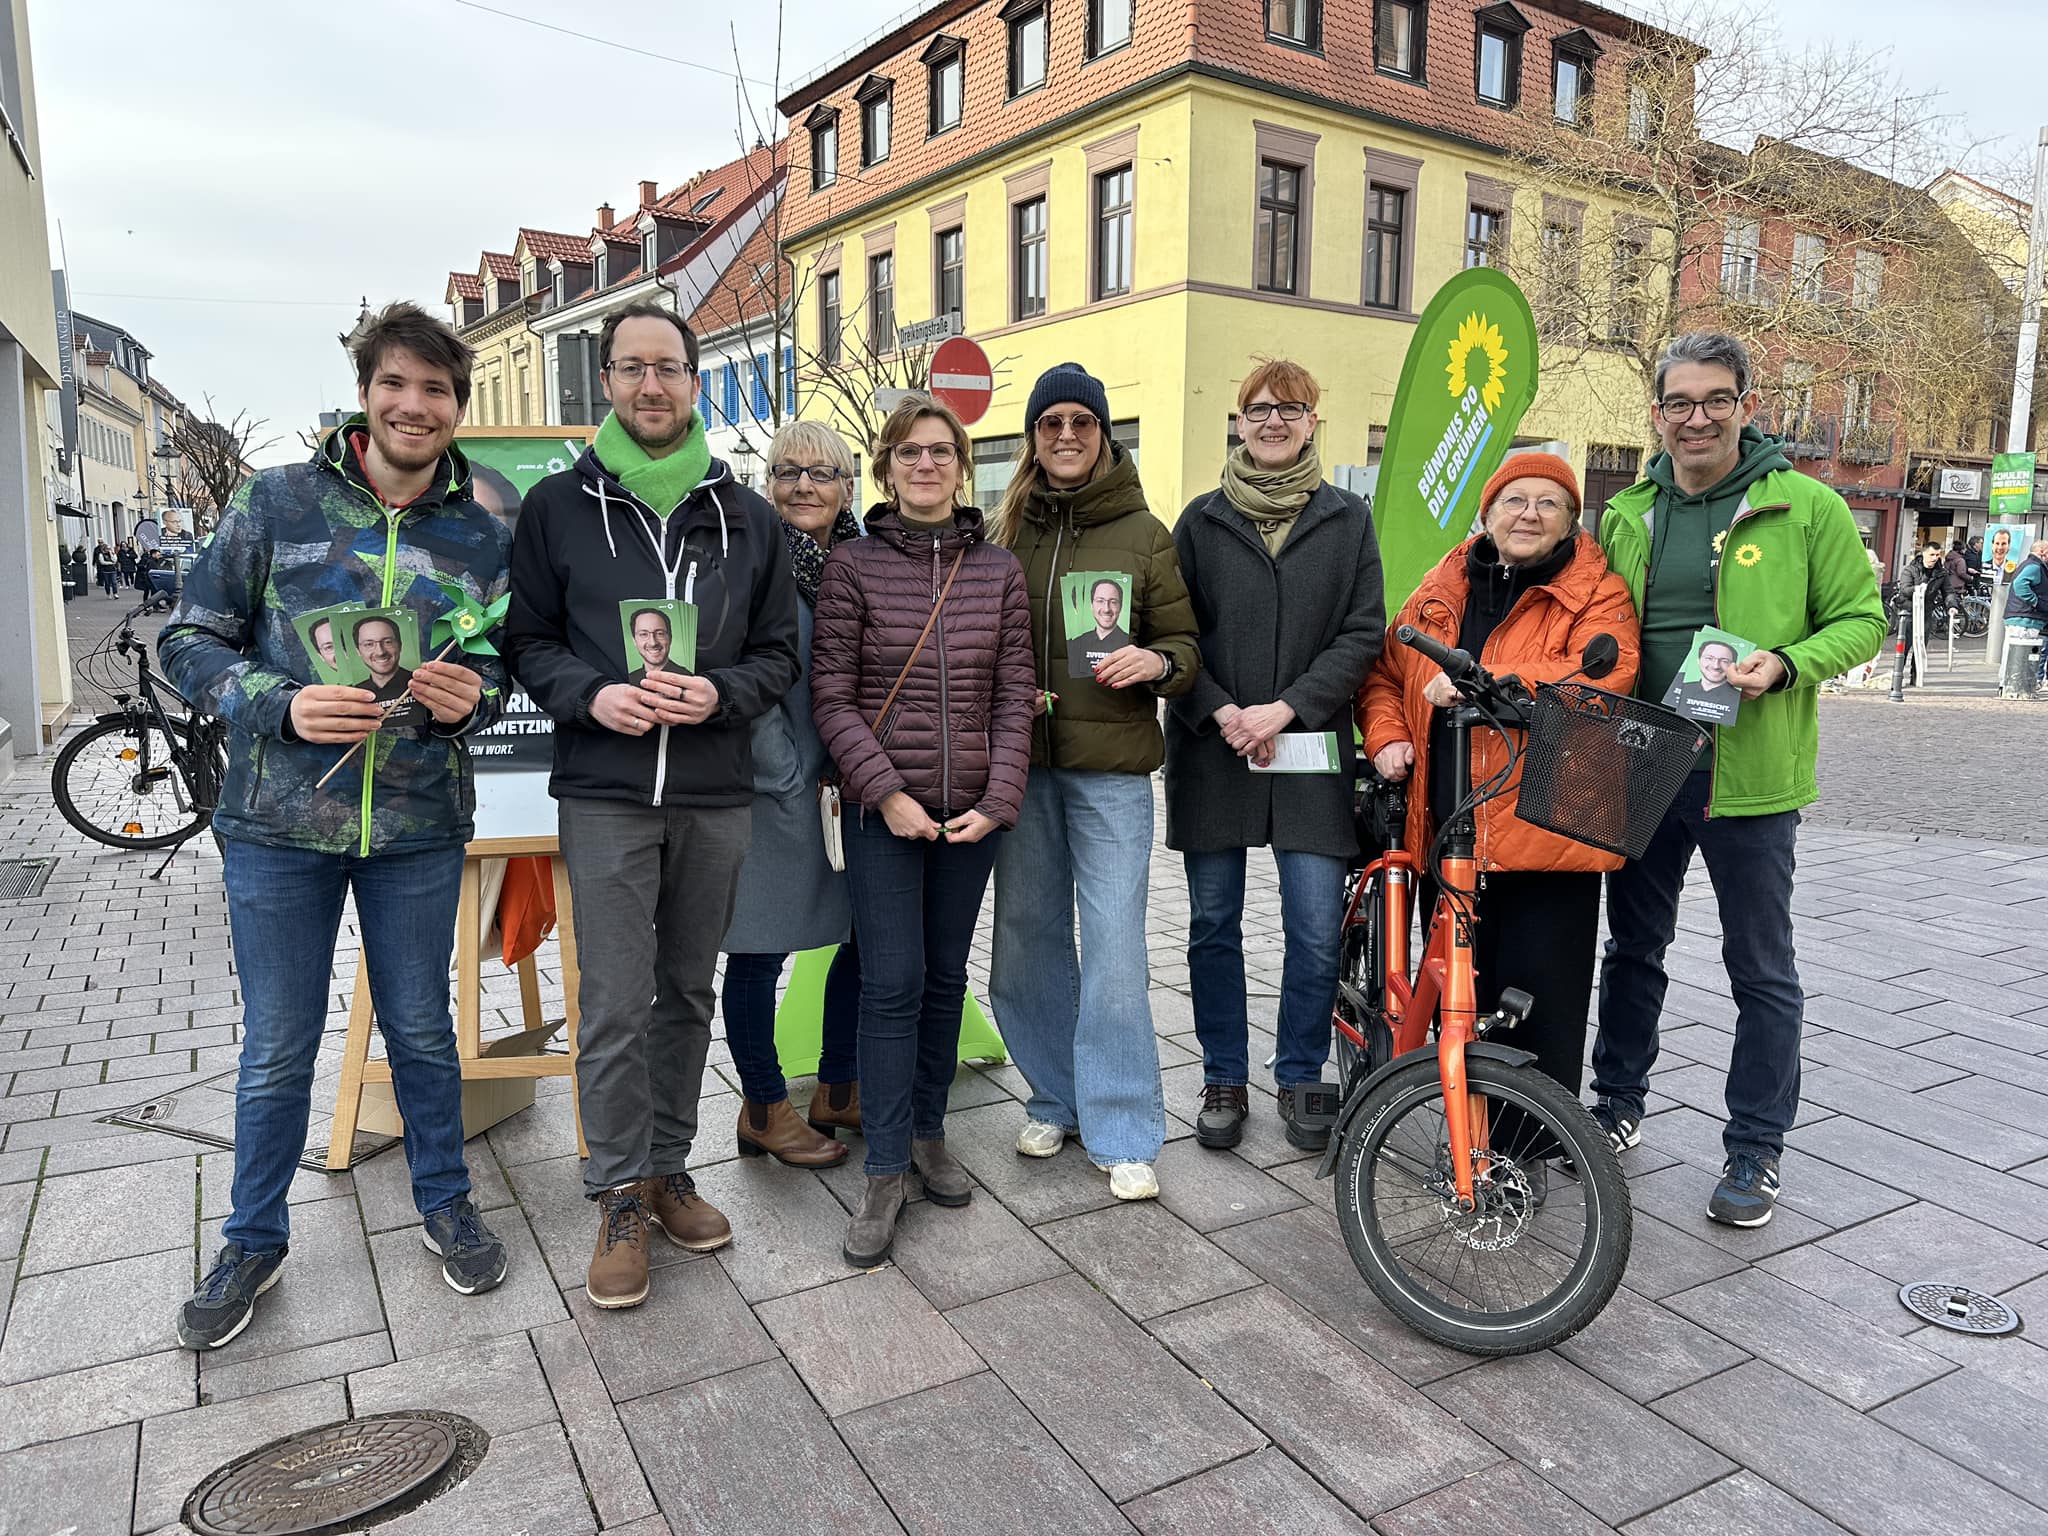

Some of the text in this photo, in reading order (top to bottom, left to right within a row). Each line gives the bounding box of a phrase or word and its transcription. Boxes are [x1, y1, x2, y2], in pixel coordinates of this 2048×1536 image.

[1417, 384, 1478, 500] BÜNDNIS 90
[1427, 402, 1488, 519] DIE GRÜNEN
[485, 744, 514, 755] WORT.
[1349, 1153, 1359, 1212] SCHWALBE
